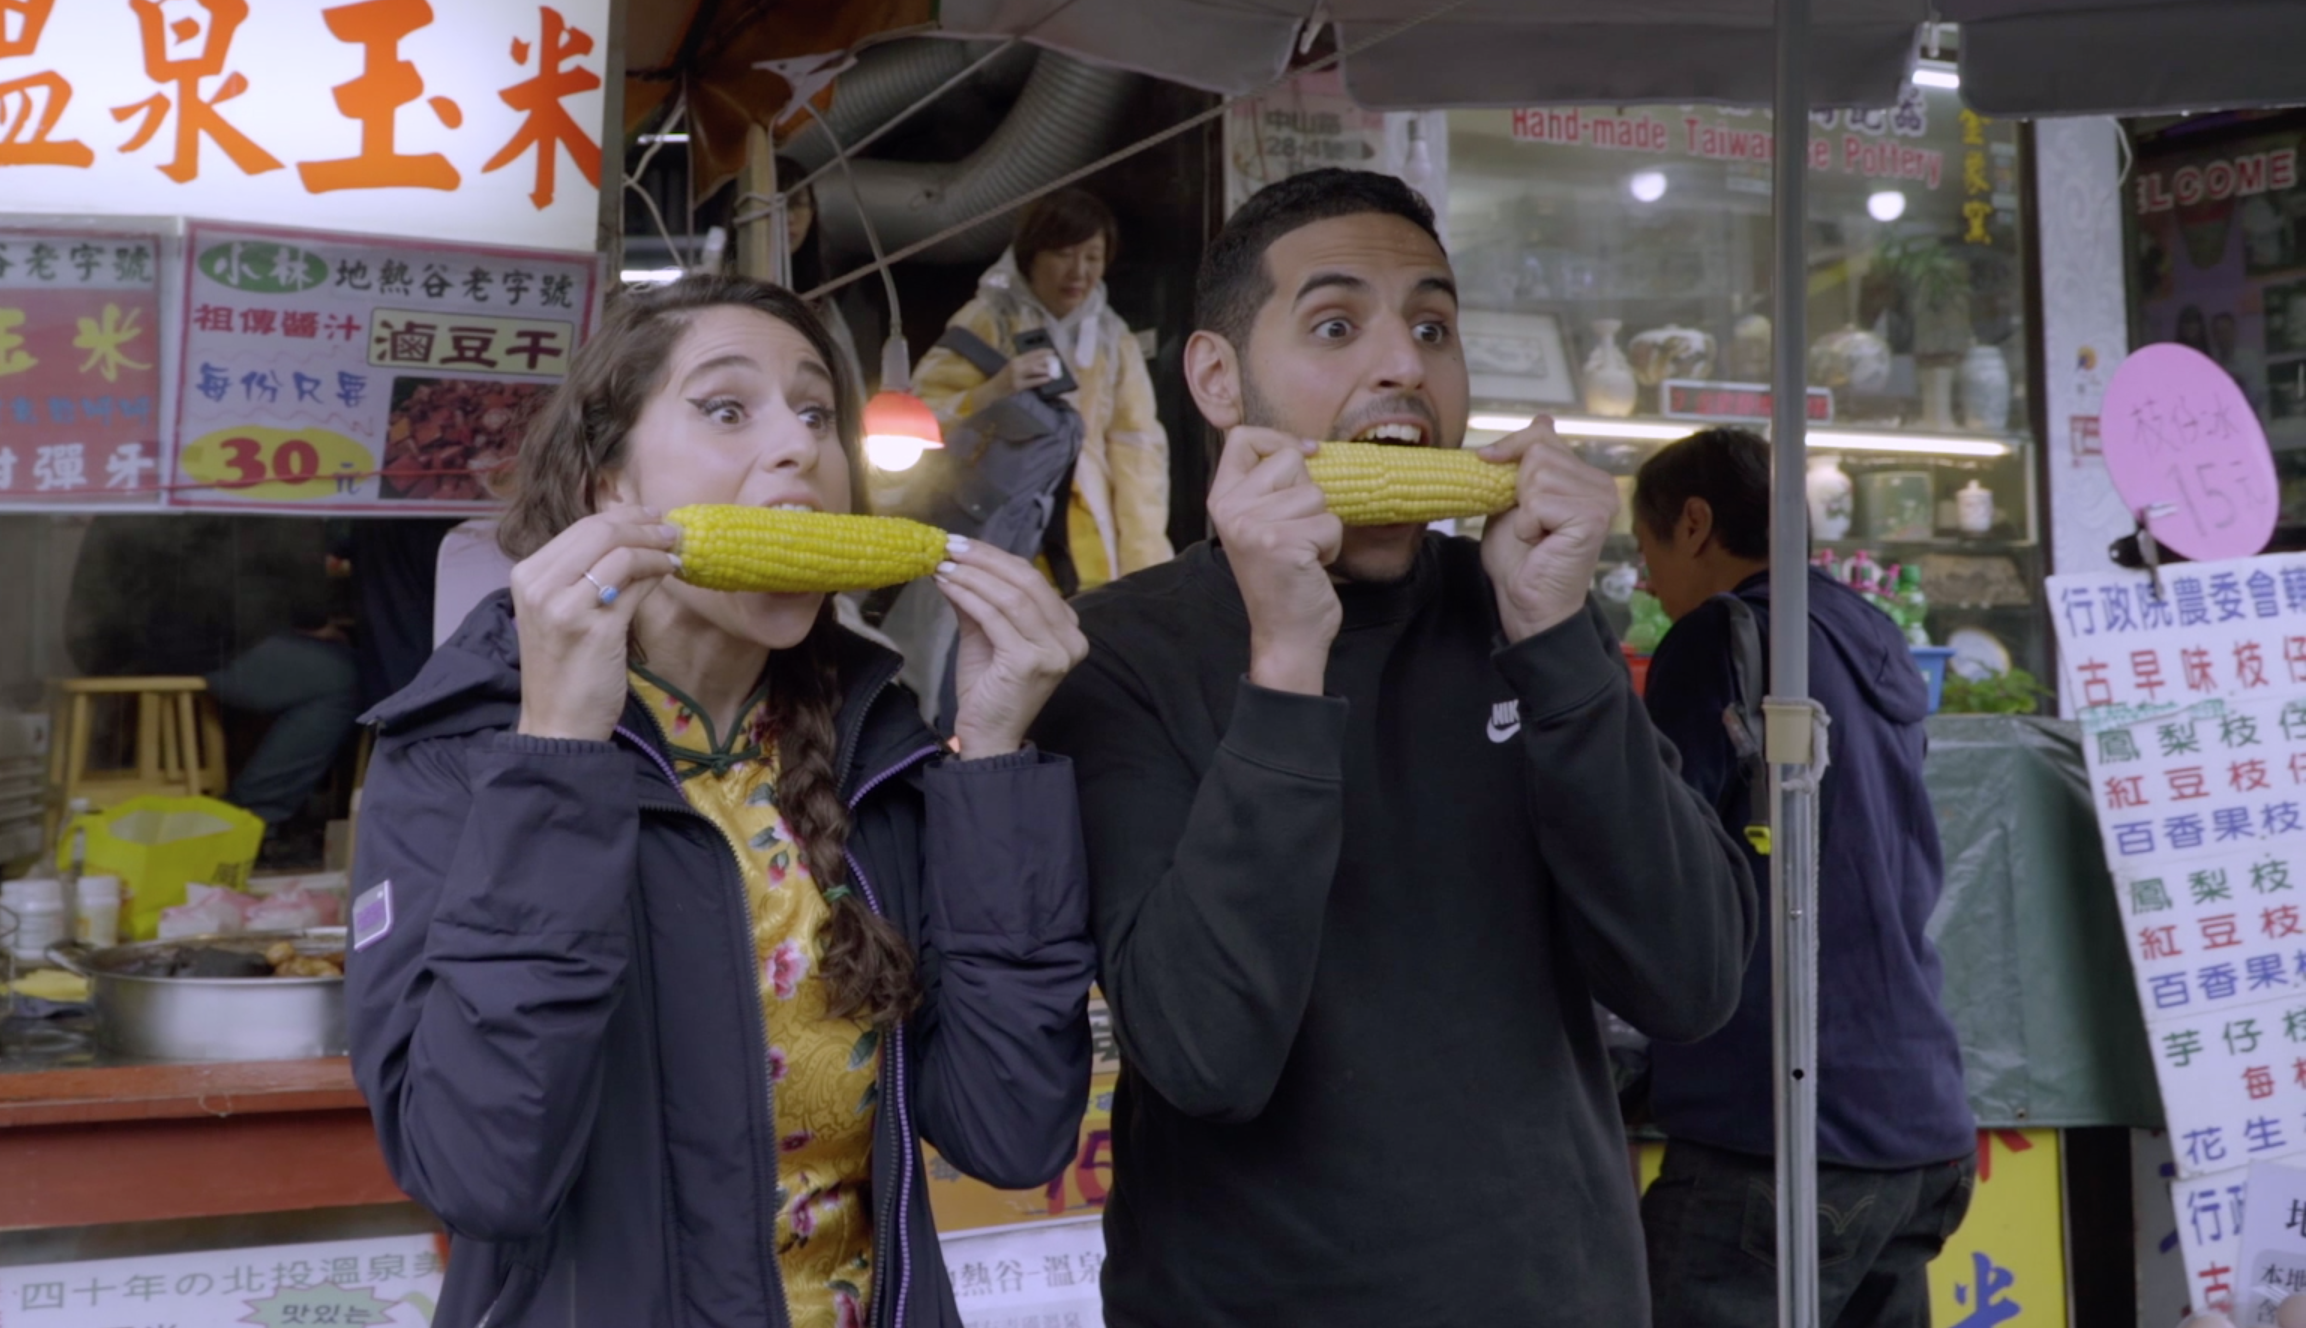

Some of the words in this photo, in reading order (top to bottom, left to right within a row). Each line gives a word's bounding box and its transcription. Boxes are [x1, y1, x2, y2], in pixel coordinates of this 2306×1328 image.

[1513, 106, 1666, 150] Hand-made
[1684, 117, 1830, 169] Taiwae
[1844, 134, 1943, 189] Pottery
[335, 258, 574, 308] 地熱谷老字號
[194, 304, 362, 343] 祖傳醬汁
[373, 320, 563, 370] 滷豆干
[195, 362, 368, 408] 每份只要
[2113, 801, 2303, 857] 百香果枝
[2131, 859, 2293, 915] 鳳梨枝
[2138, 904, 2304, 961] 紅豆枝
[2182, 1111, 2306, 1166] 花生
[949, 1252, 1102, 1297] 熱谷-溫泉
